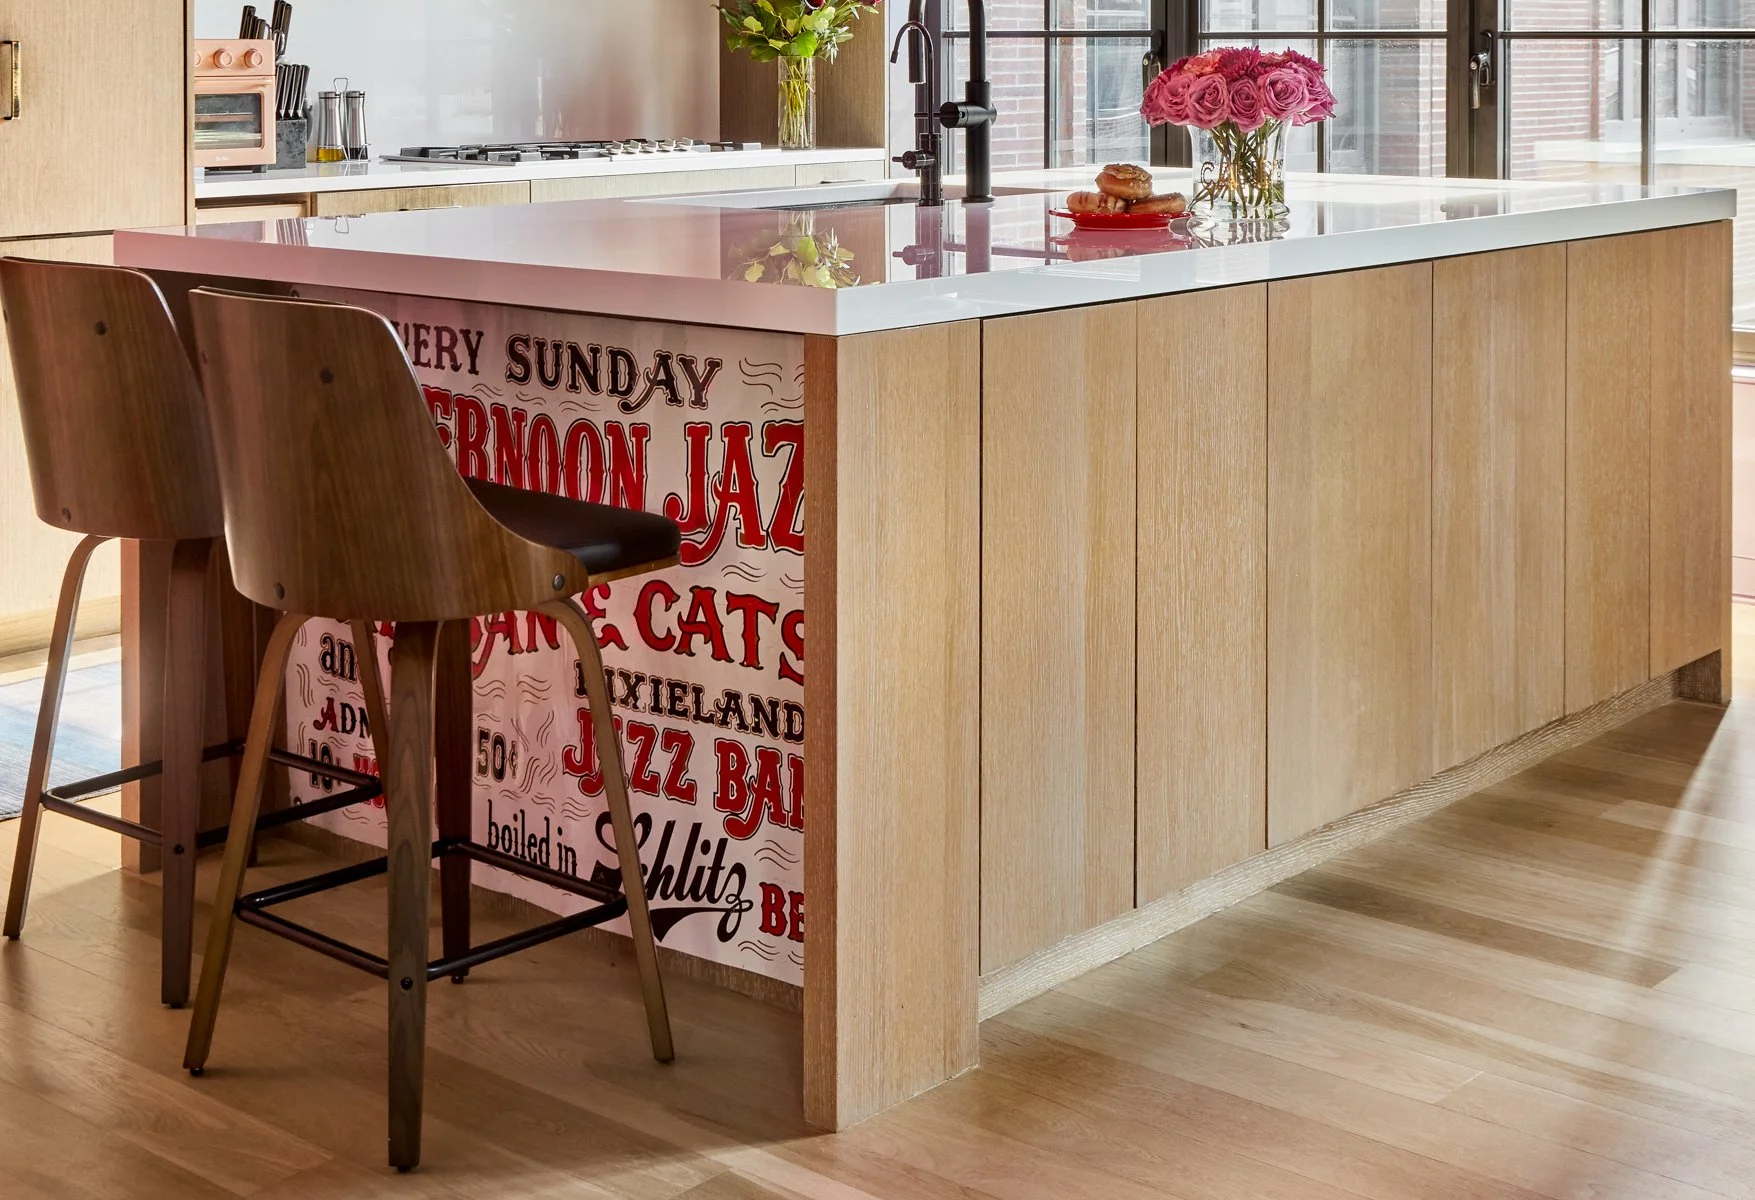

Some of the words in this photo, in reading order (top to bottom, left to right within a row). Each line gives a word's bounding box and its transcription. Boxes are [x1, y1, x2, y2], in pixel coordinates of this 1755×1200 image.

[505, 333, 724, 414] SUNDAY
[318, 632, 360, 684] an
[633, 579, 804, 686] CATS
[475, 725, 518, 783] 50¢
[562, 707, 697, 806] JZZ
[487, 799, 550, 869] boiled
[556, 826, 578, 877] in
[590, 810, 754, 944] Shlitz
